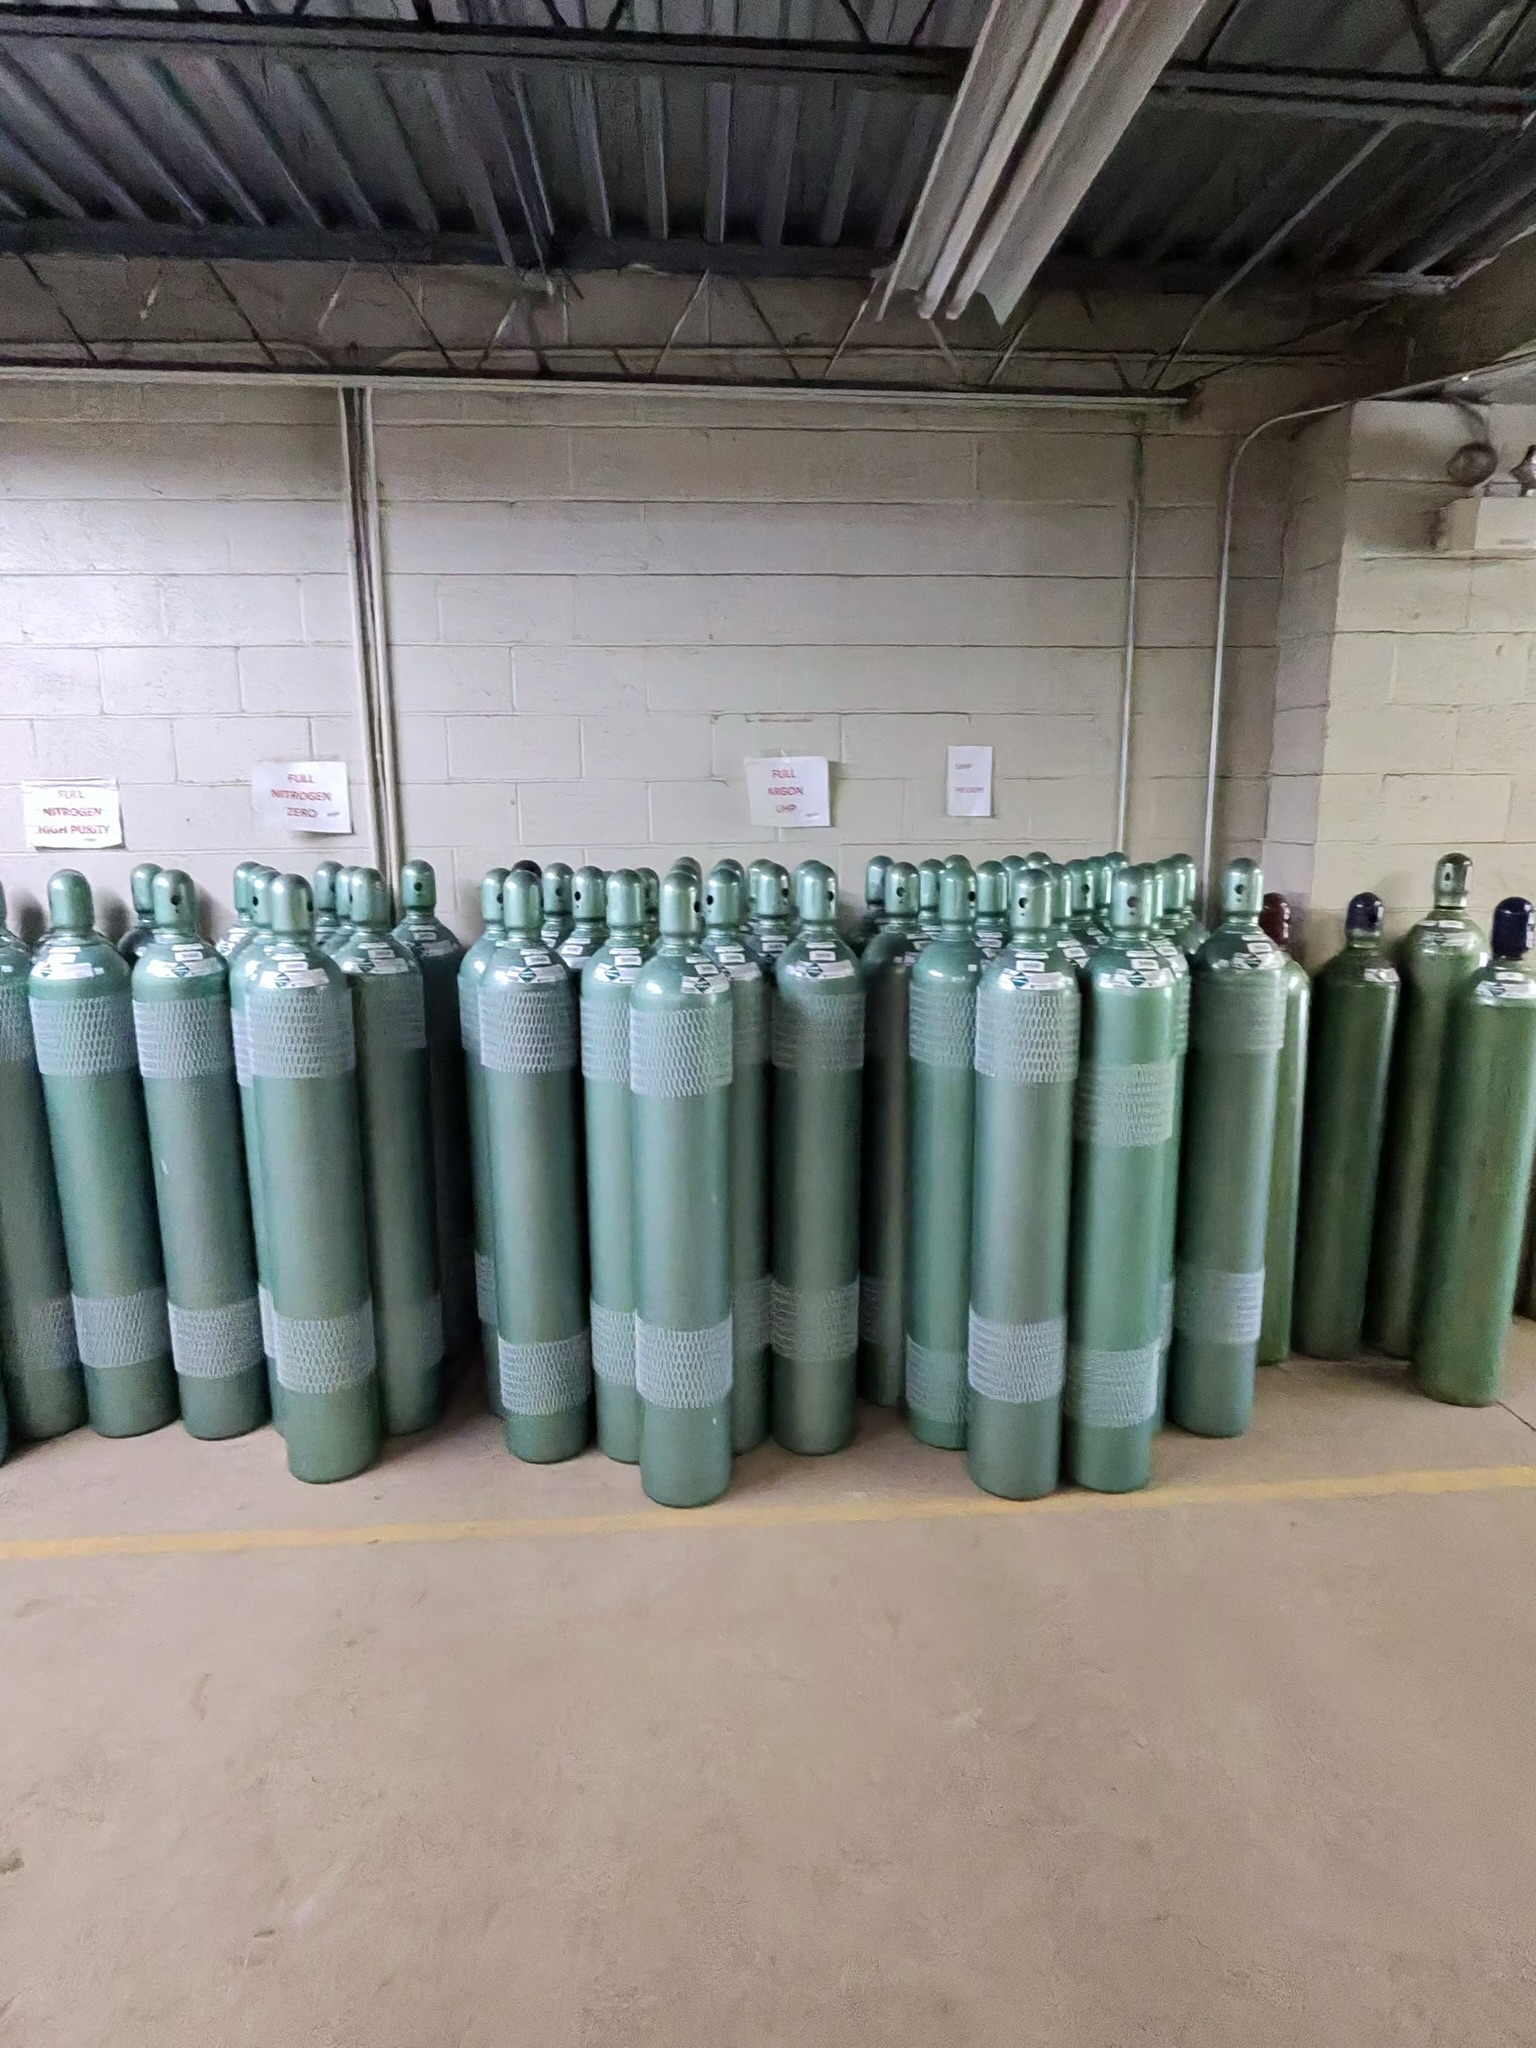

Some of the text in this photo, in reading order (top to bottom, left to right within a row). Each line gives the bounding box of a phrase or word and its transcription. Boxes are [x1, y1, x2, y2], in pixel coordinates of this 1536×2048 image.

[287, 773, 316, 783] FULL
[772, 768, 796, 778] FULL
[42, 807, 102, 816] NITROGEN
